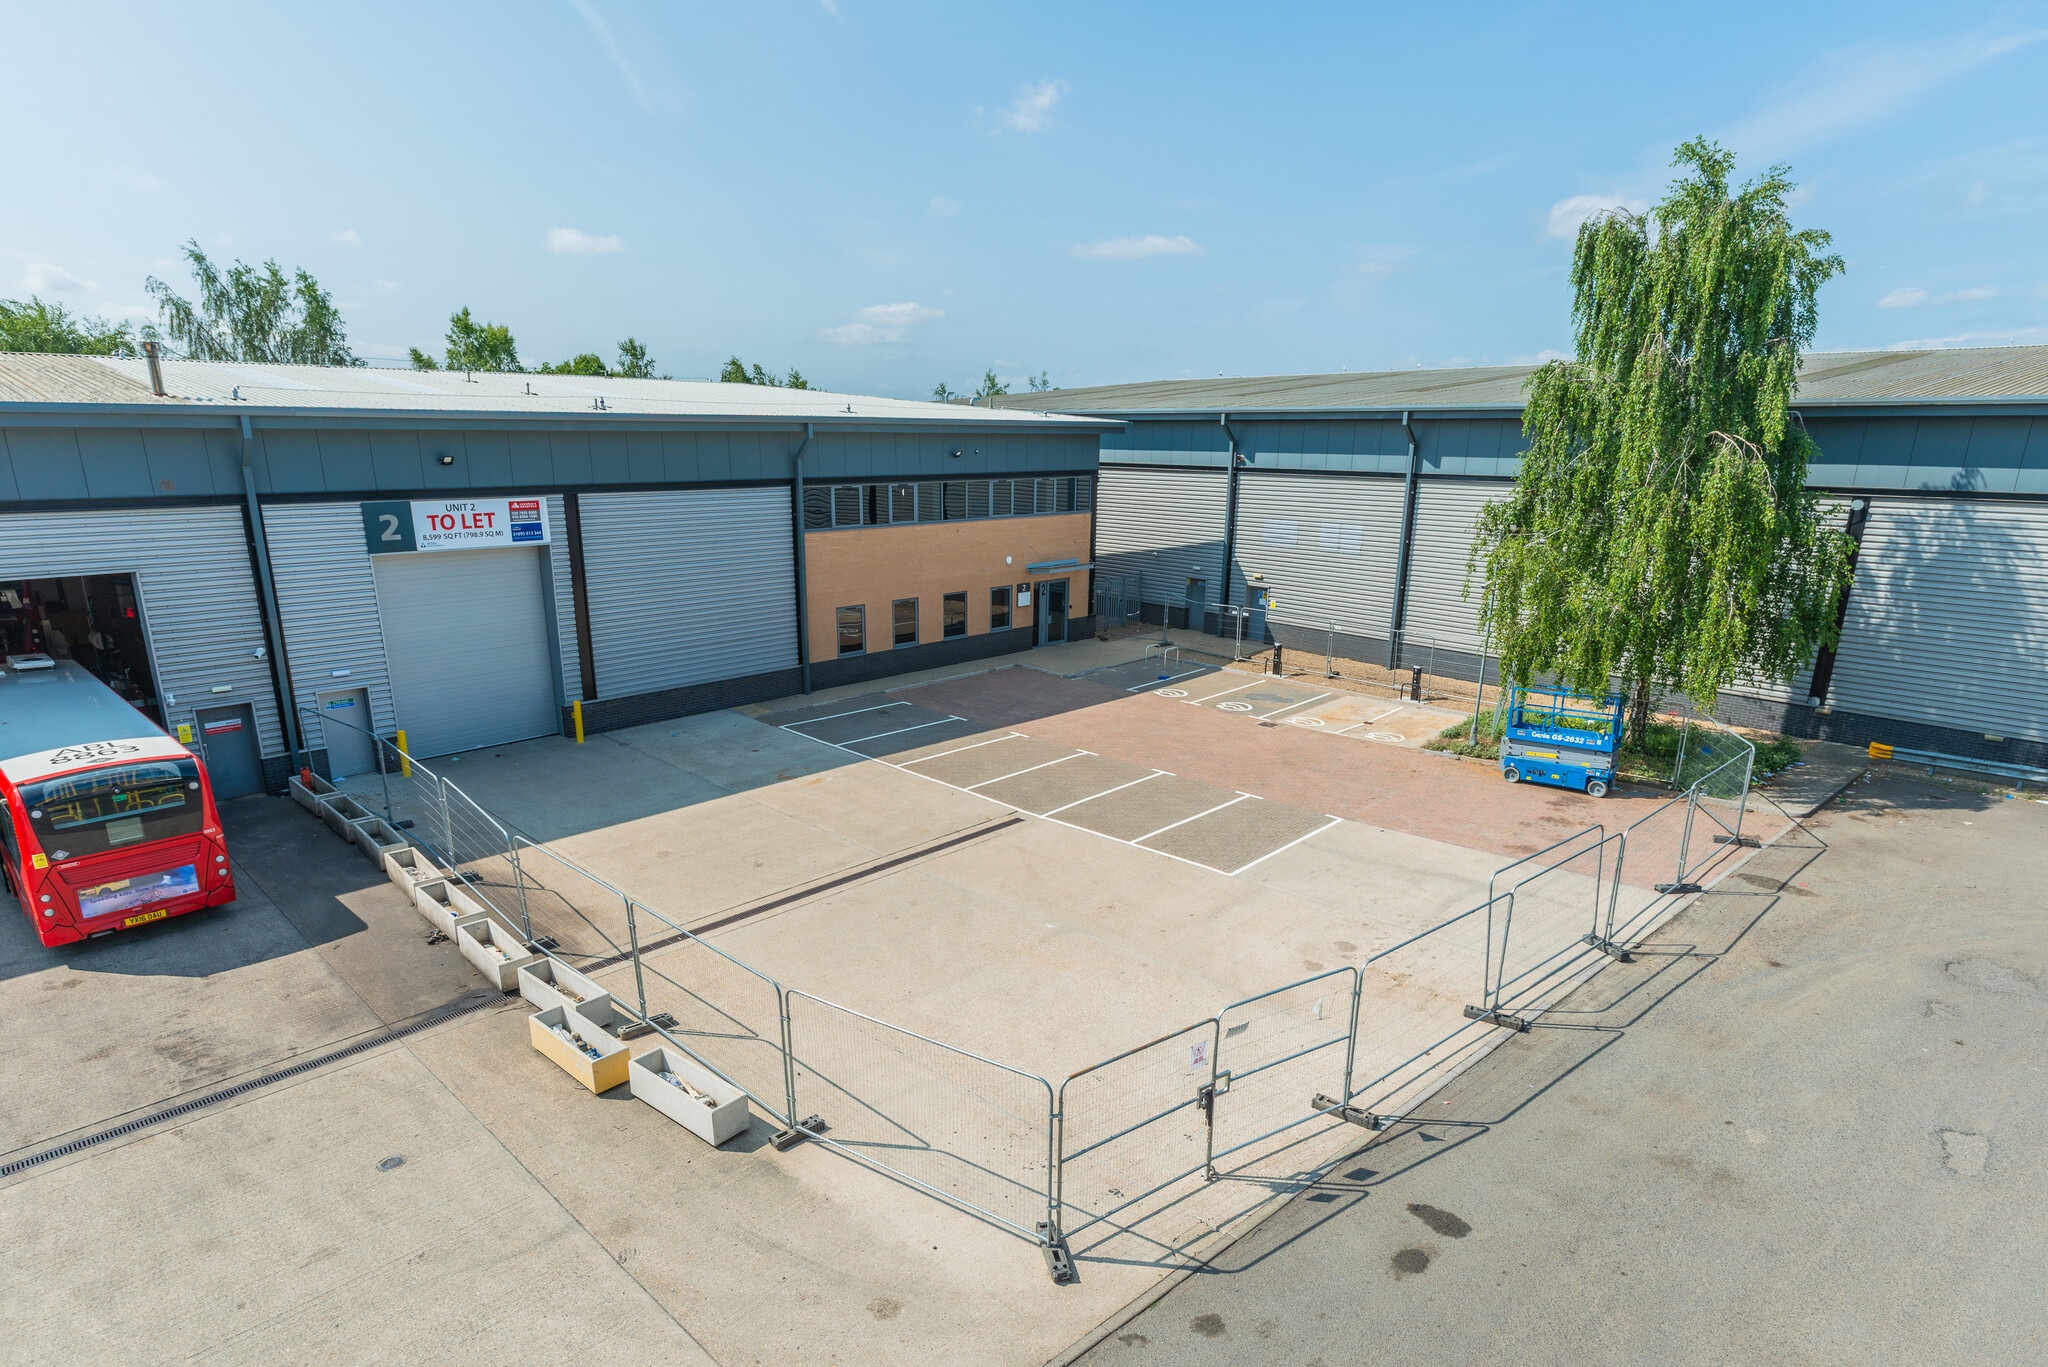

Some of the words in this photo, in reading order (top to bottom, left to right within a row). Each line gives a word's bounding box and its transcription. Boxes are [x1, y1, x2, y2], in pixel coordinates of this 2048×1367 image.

[445, 503, 467, 512] UNIT
[470, 503, 476, 511] 2
[426, 514, 456, 531] TO
[460, 512, 496, 530] LET
[378, 514, 402, 542] 2
[463, 531, 484, 539] (798.9
[1041, 584, 1046, 596] 2
[1552, 734, 1585, 744] GS-2632
